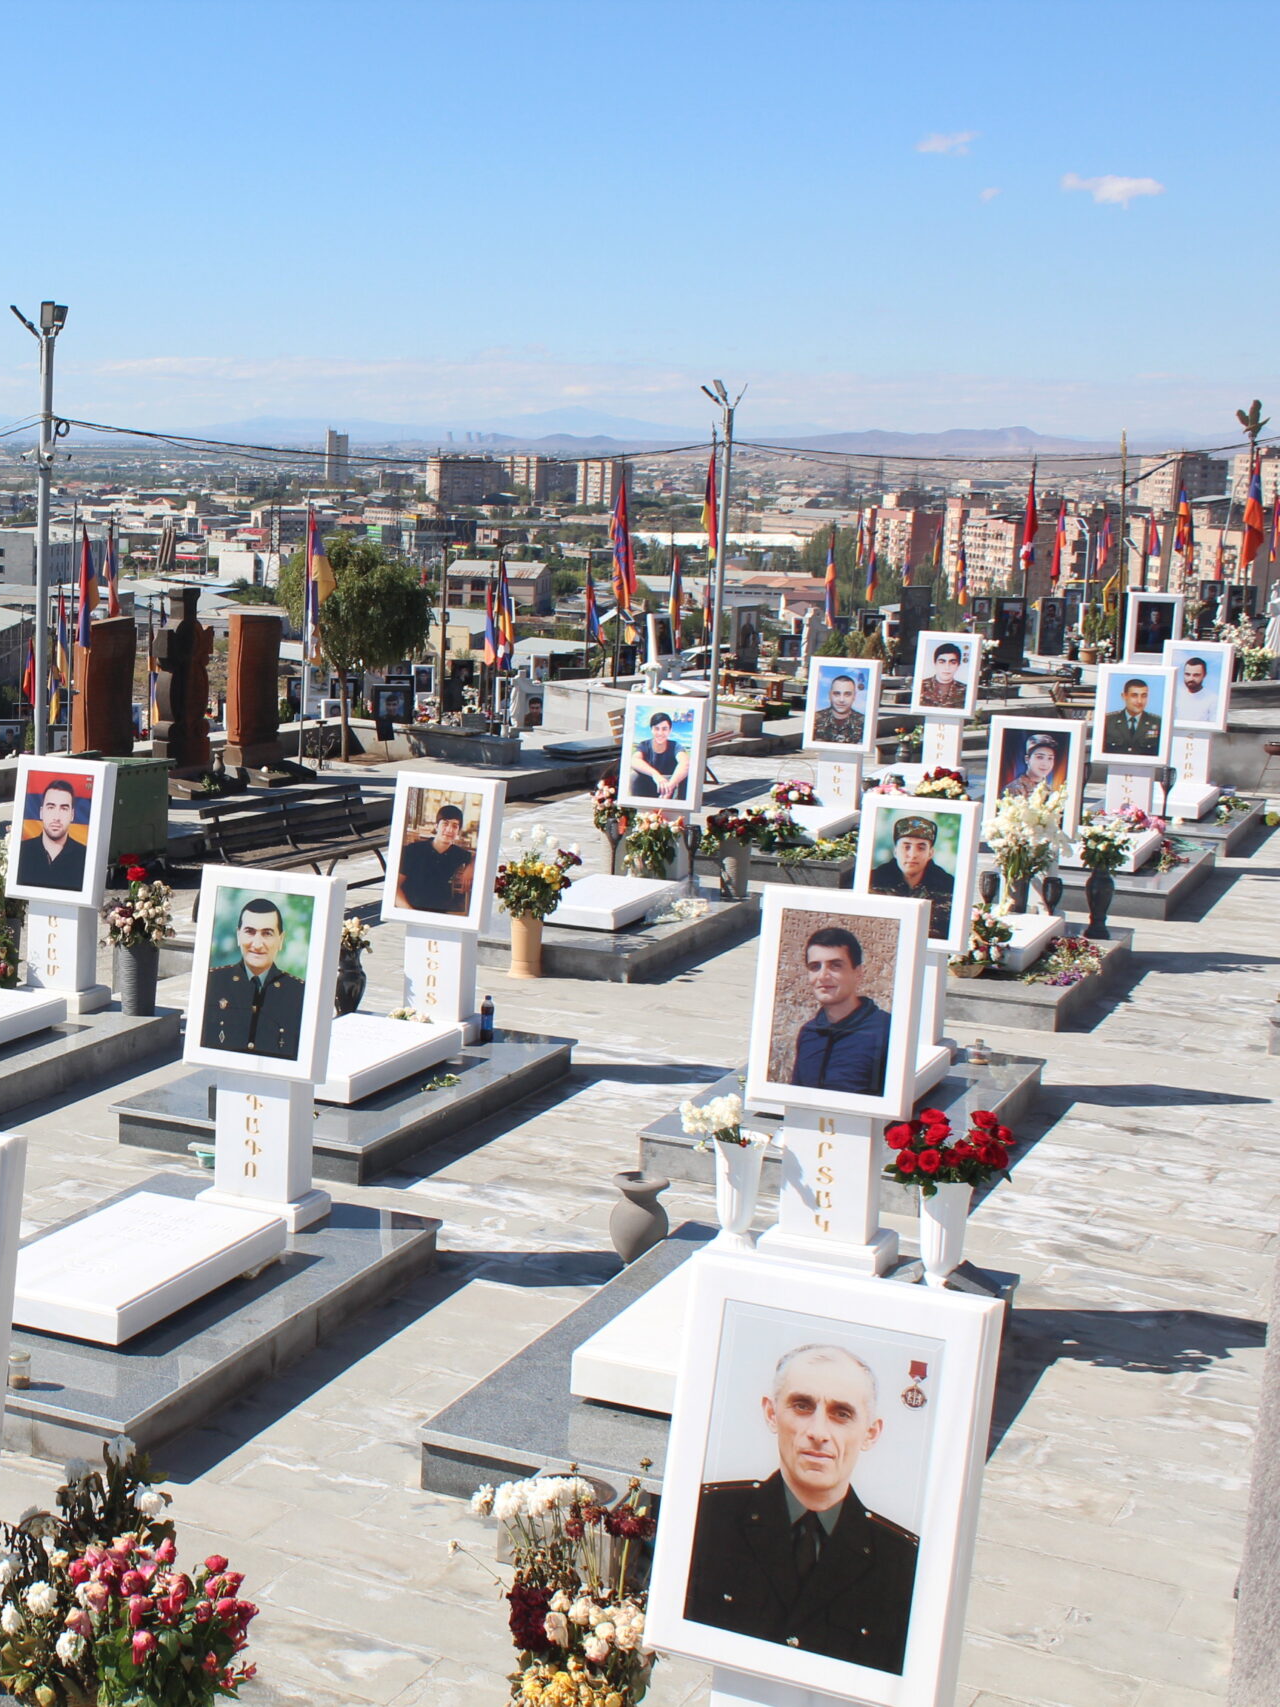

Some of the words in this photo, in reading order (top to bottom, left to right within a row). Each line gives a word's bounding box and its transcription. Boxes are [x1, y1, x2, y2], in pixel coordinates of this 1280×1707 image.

[47, 915, 60, 976] ԱՐԱՄ
[426, 940, 439, 1005] ԱՇՈՏ
[244, 1094, 263, 1178] ԳԱԳՈ
[815, 1117, 836, 1232] ԱՐՏԱԿ
